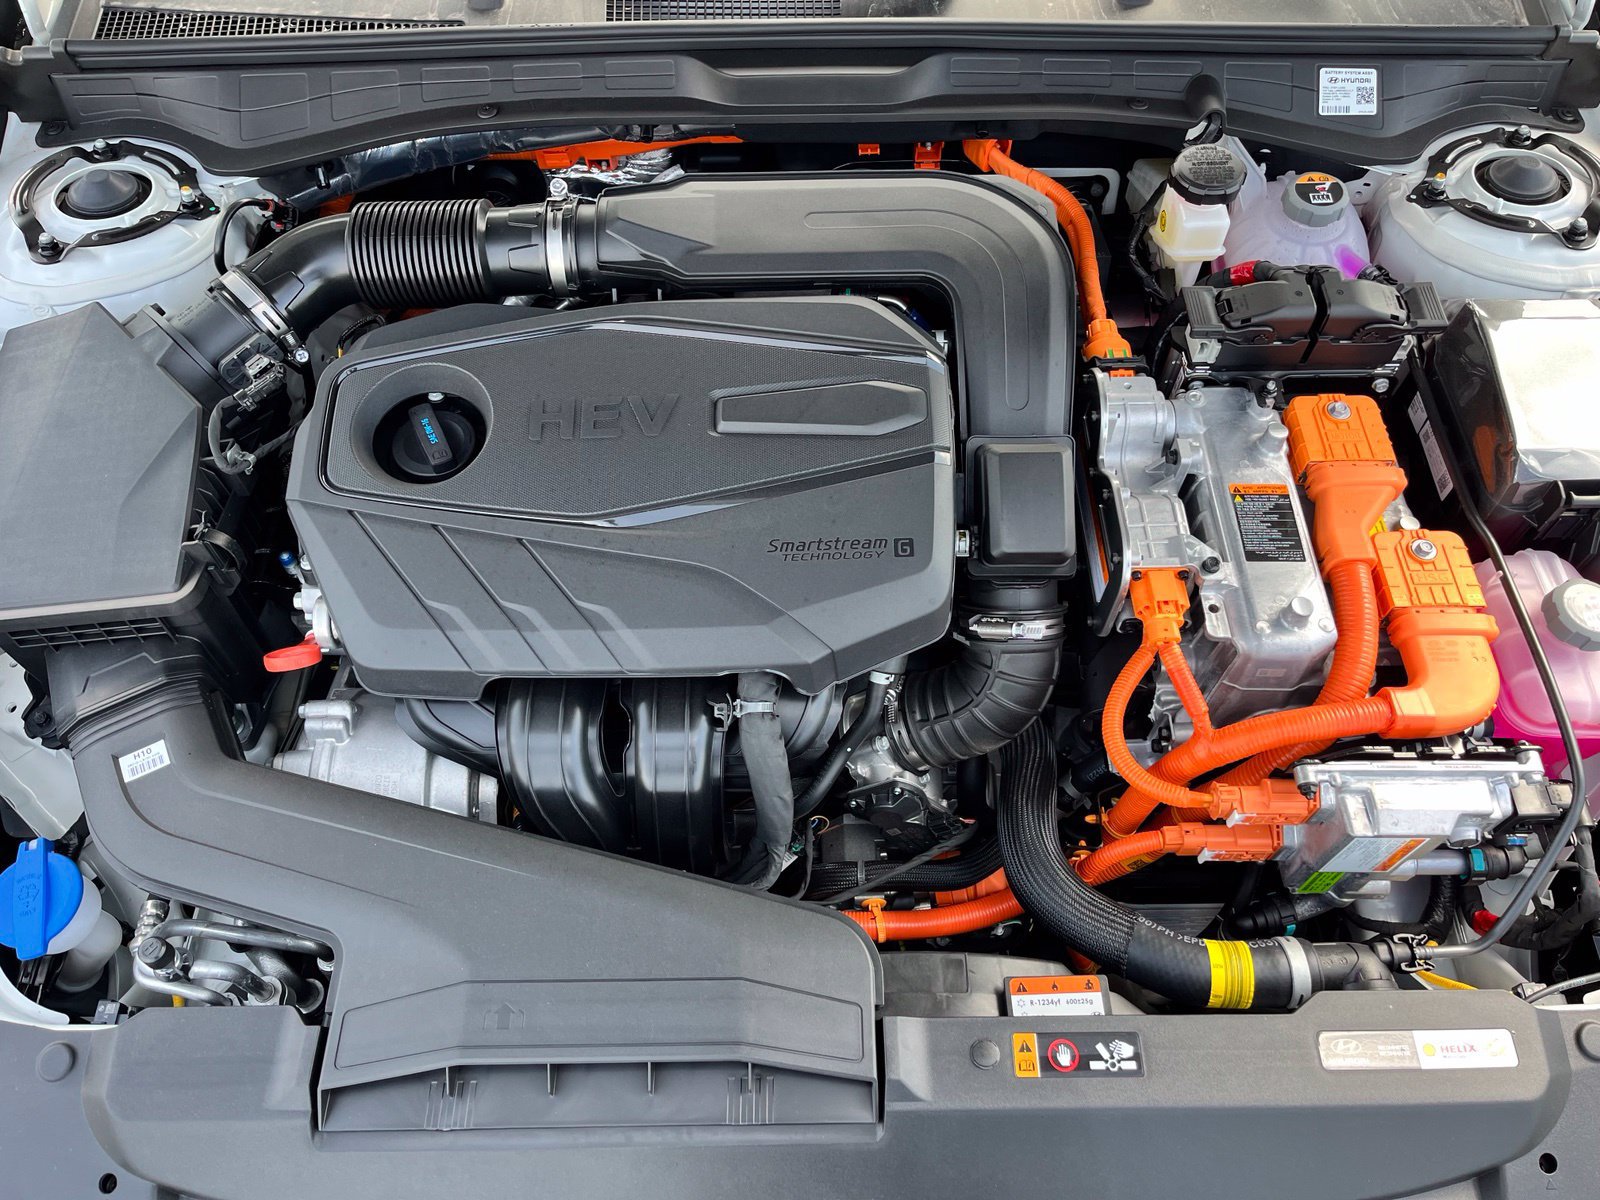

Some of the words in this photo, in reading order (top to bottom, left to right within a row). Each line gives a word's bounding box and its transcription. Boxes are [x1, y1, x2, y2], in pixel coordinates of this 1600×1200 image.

[528, 393, 680, 441] HEV
[767, 537, 889, 553] Smartstream
[896, 539, 912, 556] G
[782, 550, 885, 562] TECHNOLOGY
[133, 747, 153, 760] H10
[1029, 998, 1061, 1007] R-1234yf
[1440, 1044, 1477, 1054] HELIX
